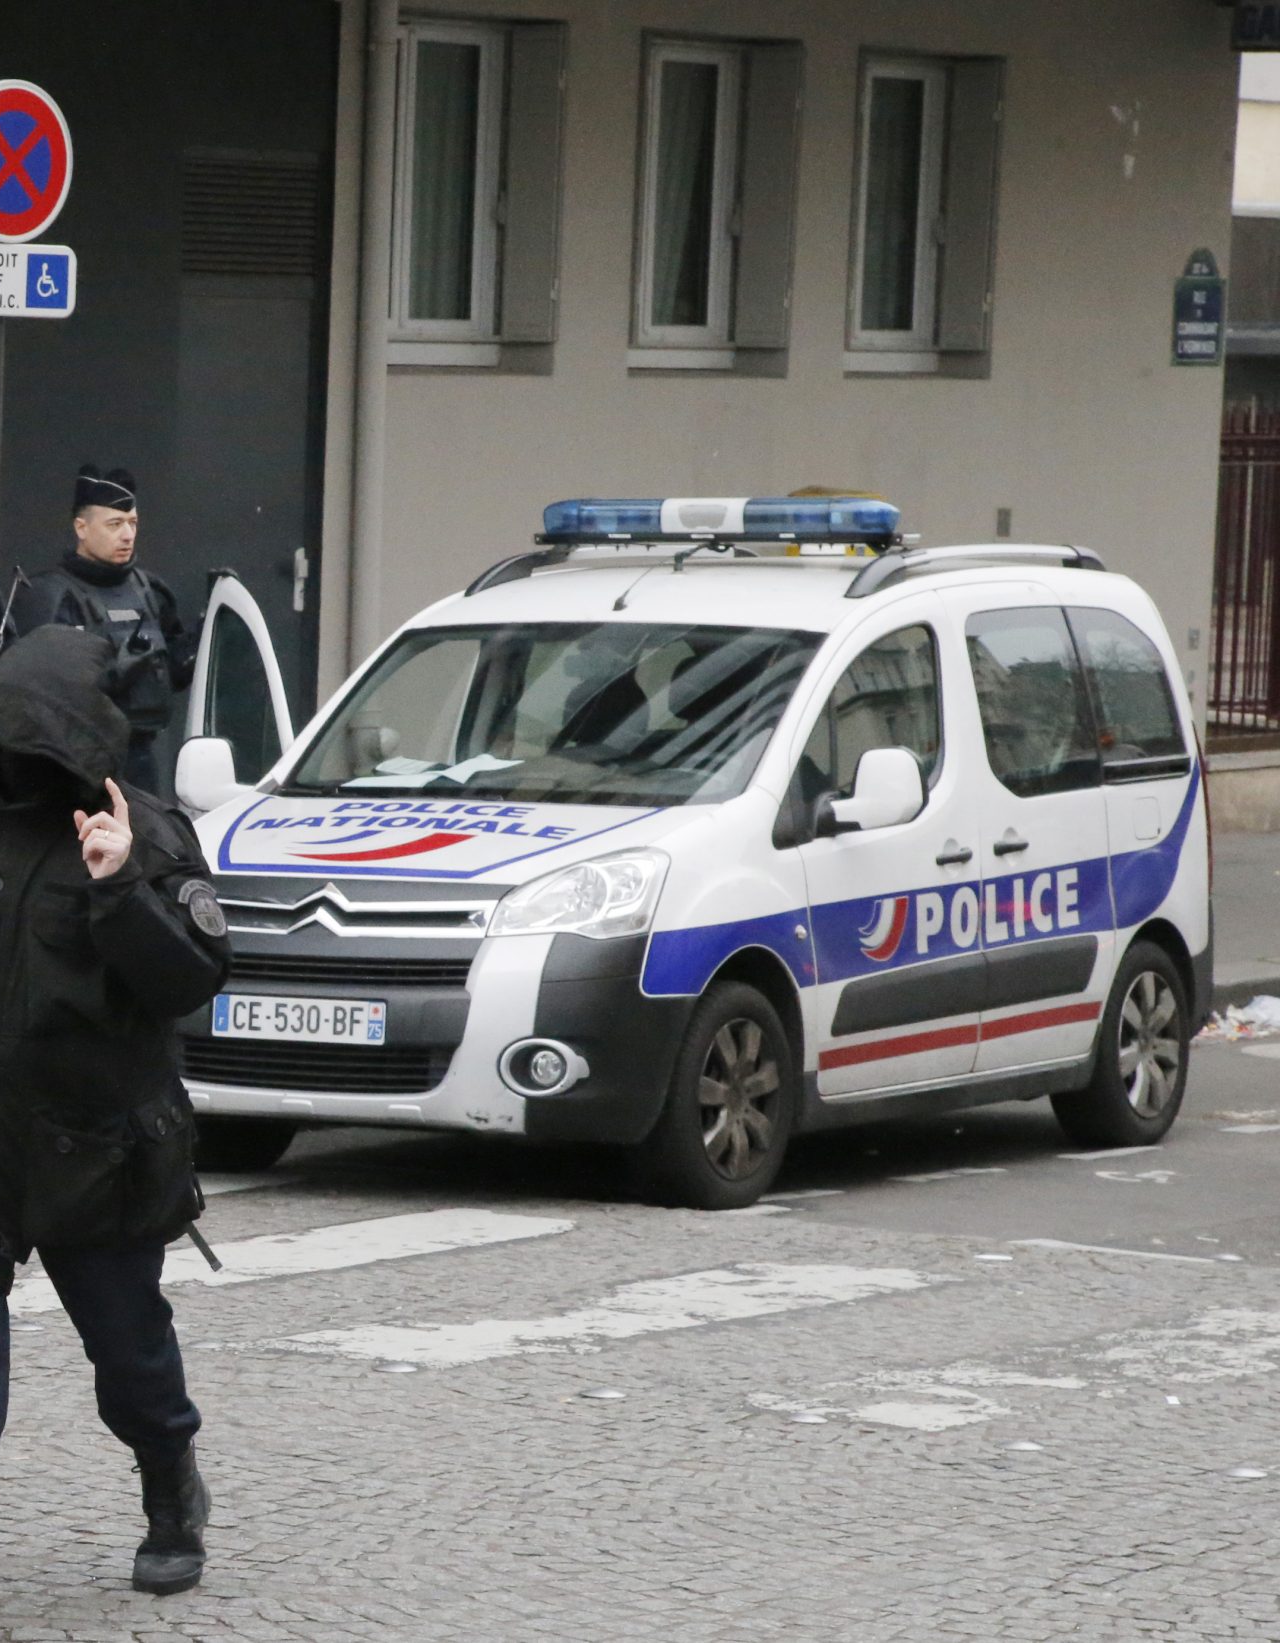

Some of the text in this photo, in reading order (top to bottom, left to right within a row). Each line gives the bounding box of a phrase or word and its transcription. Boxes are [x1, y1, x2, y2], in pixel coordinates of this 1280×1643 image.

[330, 802, 536, 818] POLICE
[244, 815, 577, 840] NATIONALE
[916, 867, 1080, 954] POLICE
[218, 1001, 382, 1038] F CE-530-BF 75
